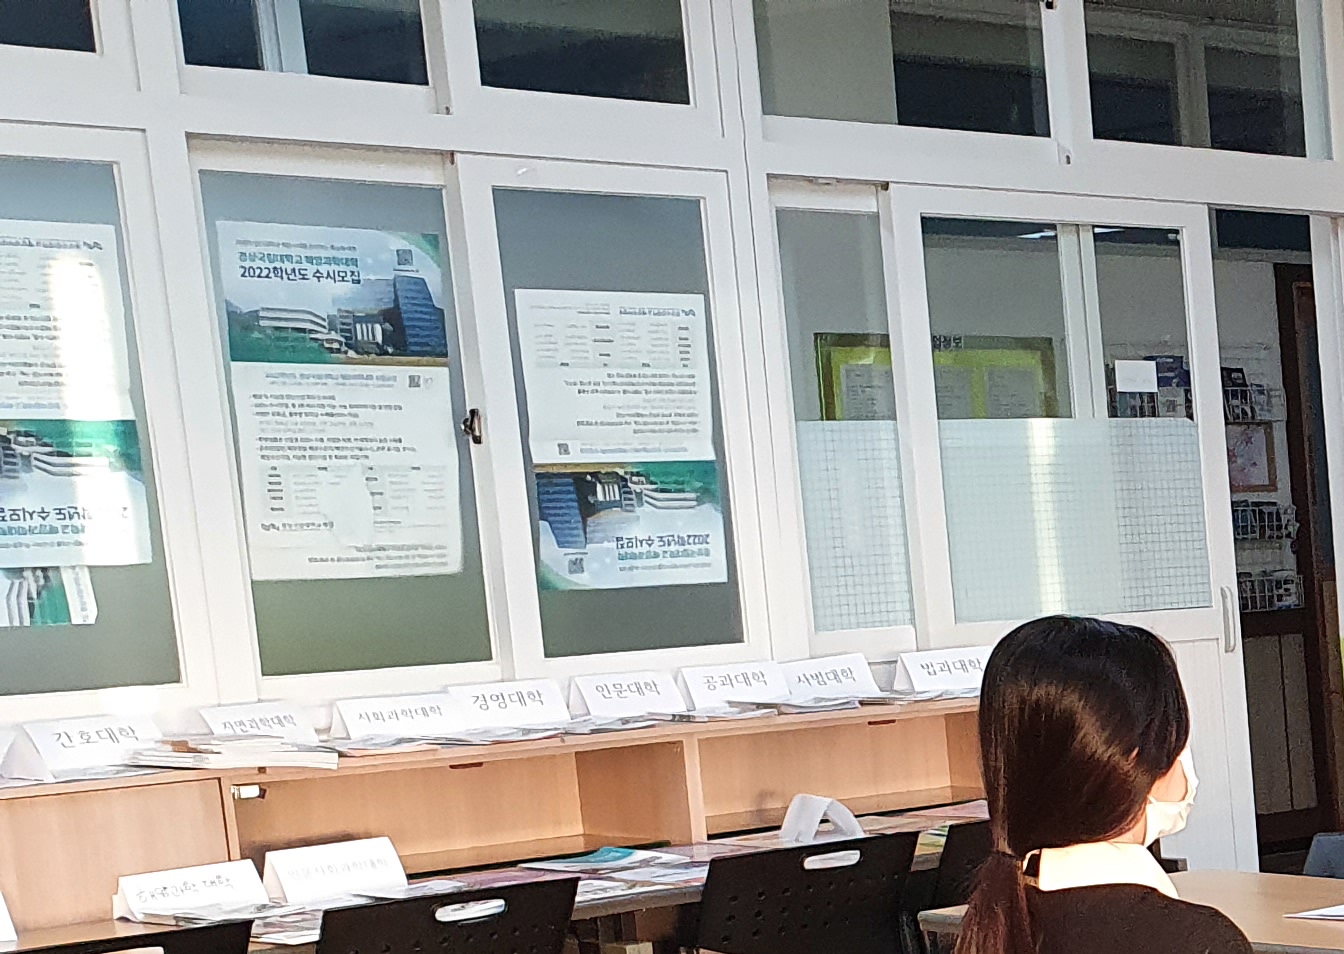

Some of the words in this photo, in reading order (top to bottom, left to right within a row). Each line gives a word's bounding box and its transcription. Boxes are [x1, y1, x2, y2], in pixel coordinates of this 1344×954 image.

[239, 265, 310, 281] 2022학년도
[312, 268, 362, 285] 수시모집
[615, 535, 656, 550] 수시모집
[796, 666, 857, 687] 사범대학
[919, 657, 984, 678] 법과대학
[595, 679, 661, 700] 인문대학
[702, 669, 768, 692] 공과대학
[471, 688, 545, 711] 경영대학
[221, 713, 298, 735] 자연과학대학
[357, 703, 444, 724] 사회과학대학
[52, 724, 140, 749] 간호대학
[201, 873, 235, 890] 대학
